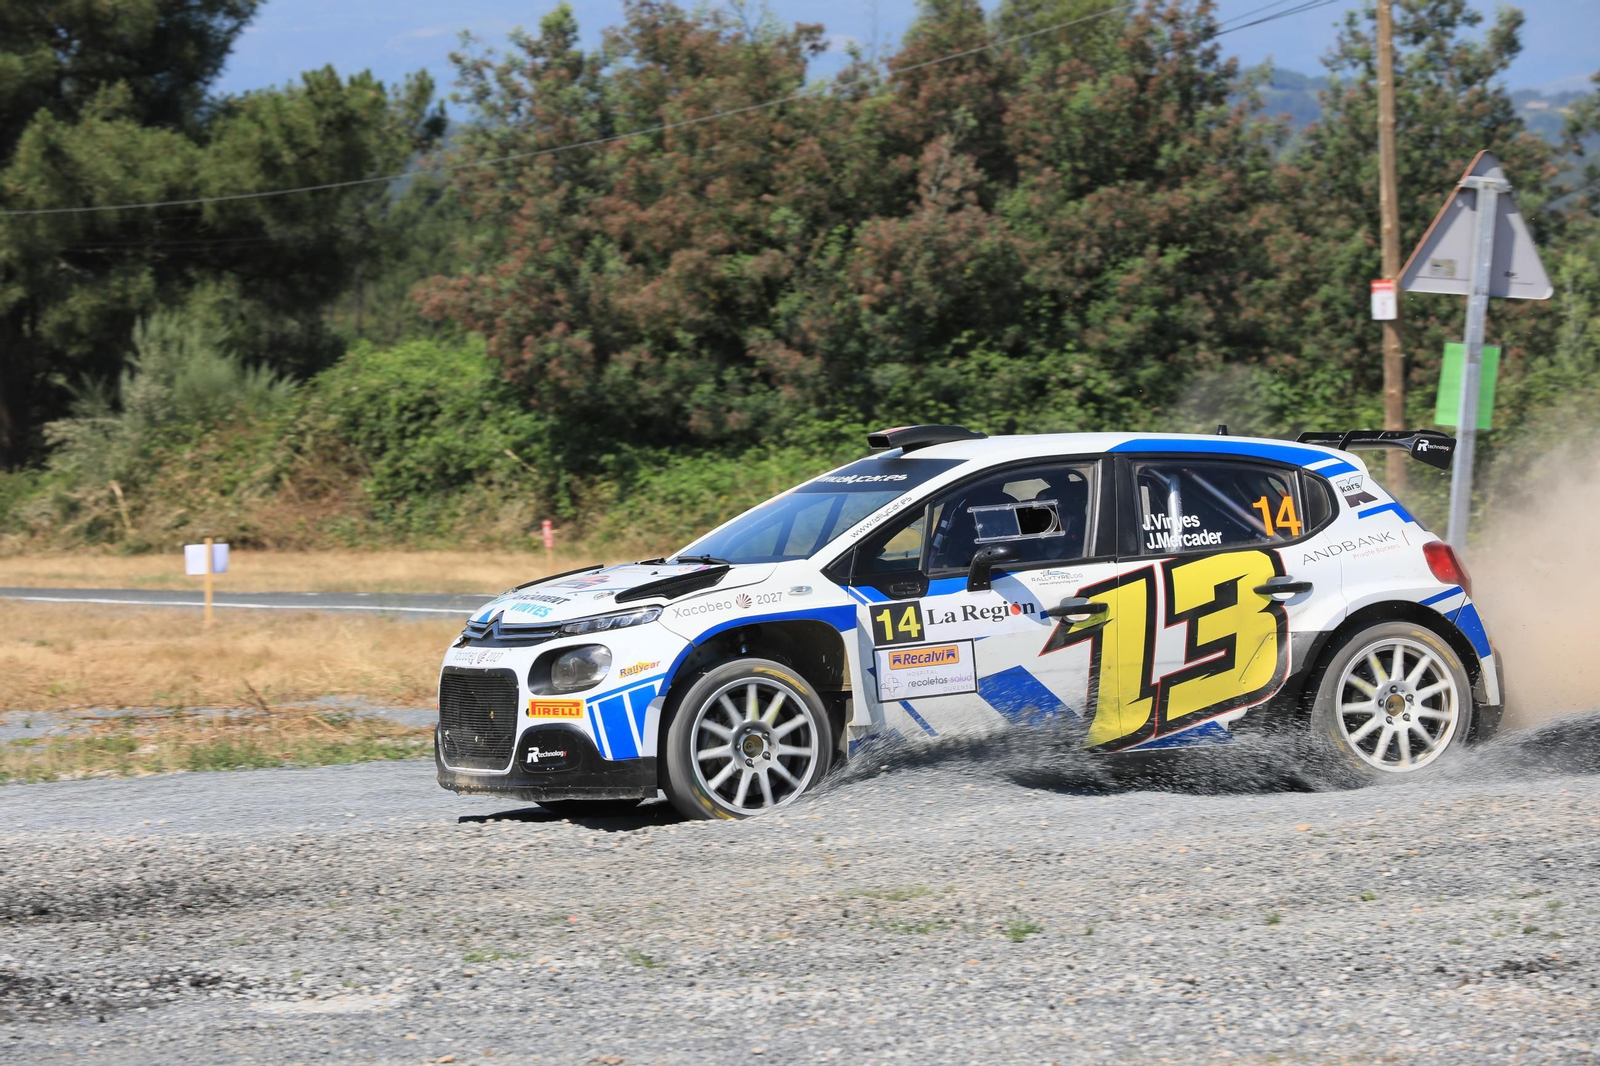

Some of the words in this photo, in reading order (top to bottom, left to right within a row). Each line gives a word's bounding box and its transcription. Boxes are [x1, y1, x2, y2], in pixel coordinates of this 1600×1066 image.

[1339, 480, 1361, 494] kars
[1142, 513, 1201, 532] J.Vinyes
[1253, 496, 1302, 536] 14
[1146, 529, 1223, 550] J.Mercader
[1303, 531, 1396, 565] ANDBANK
[510, 602, 553, 618] VINYES
[673, 600, 733, 619] Xacobeo
[756, 592, 783, 605] 2027
[876, 606, 921, 641] 14
[926, 609, 957, 626] La
[903, 650, 945, 665] Recalvi
[620, 661, 661, 677] Rallycar
[907, 675, 948, 687] recoletas
[950, 672, 973, 683] salud
[943, 684, 973, 692] OURENSE
[531, 701, 580, 716] PIRELLI
